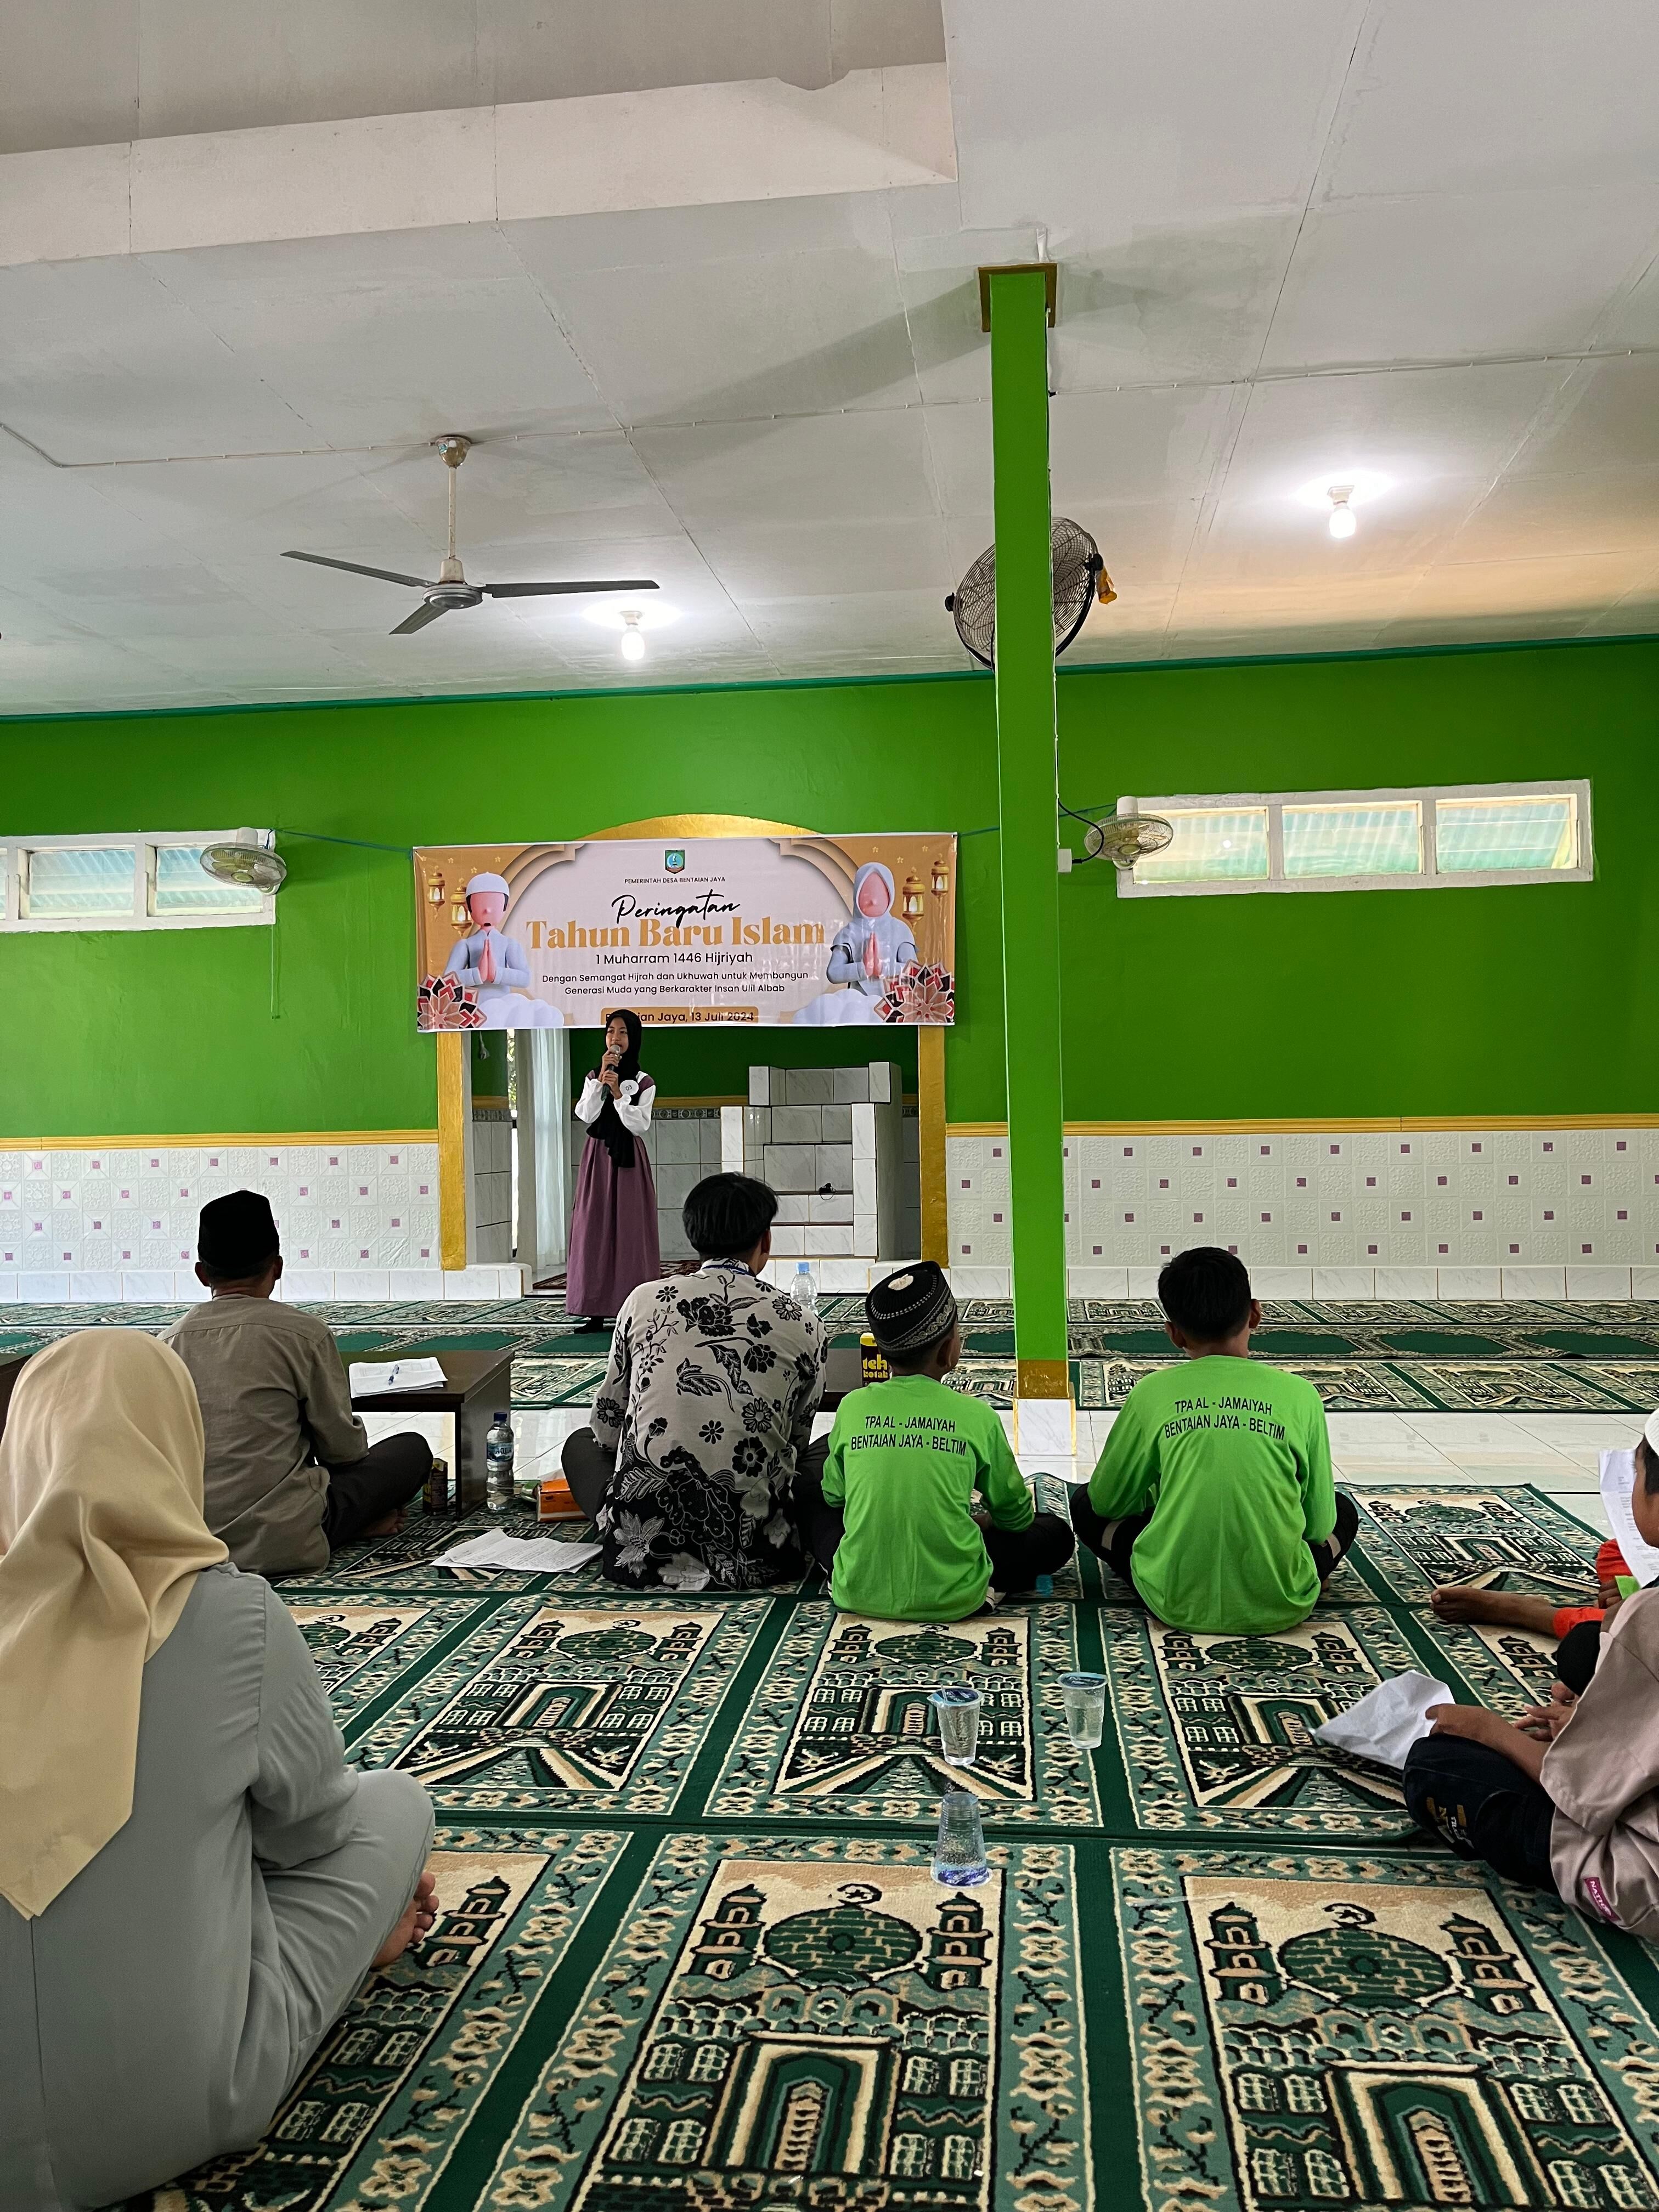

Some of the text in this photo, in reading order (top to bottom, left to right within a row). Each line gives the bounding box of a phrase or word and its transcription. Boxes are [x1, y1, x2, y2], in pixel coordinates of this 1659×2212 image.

[611, 889, 741, 928] Peringatan
[526, 916, 825, 949] Tahun Baru Islam
[596, 952, 753, 966] 1 Muharram 1446 Hijriyah
[543, 975, 577, 984] Dengan
[579, 974, 625, 983] Semangat
[628, 973, 654, 982] Hijrah
[749, 972, 808, 981] Membangun
[659, 985, 712, 993] Berkarakter
[658, 1013, 687, 1024] Jaya,
[691, 1012, 701, 1022] 13
[727, 1012, 754, 1021] 2024
[862, 1354, 888, 1370] teh
[863, 1370, 888, 1378] kotak
[1175, 1399, 1193, 1414] TPA
[1195, 1397, 1209, 1409] AL
[1218, 1396, 1272, 1416] JAMAIYAH
[865, 1415, 881, 1429] TPA
[883, 1416, 896, 1428] AL
[905, 1417, 956, 1433] JAMAIYAH
[1165, 1414, 1210, 1439] BENTAIAN
[1214, 1414, 1240, 1430] JAYA
[1249, 1417, 1285, 1440] BELTIM
[851, 1434, 896, 1450] BENTAIAN
[899, 1434, 923, 1448] JAYA
[932, 1436, 967, 1456] BELTIM
